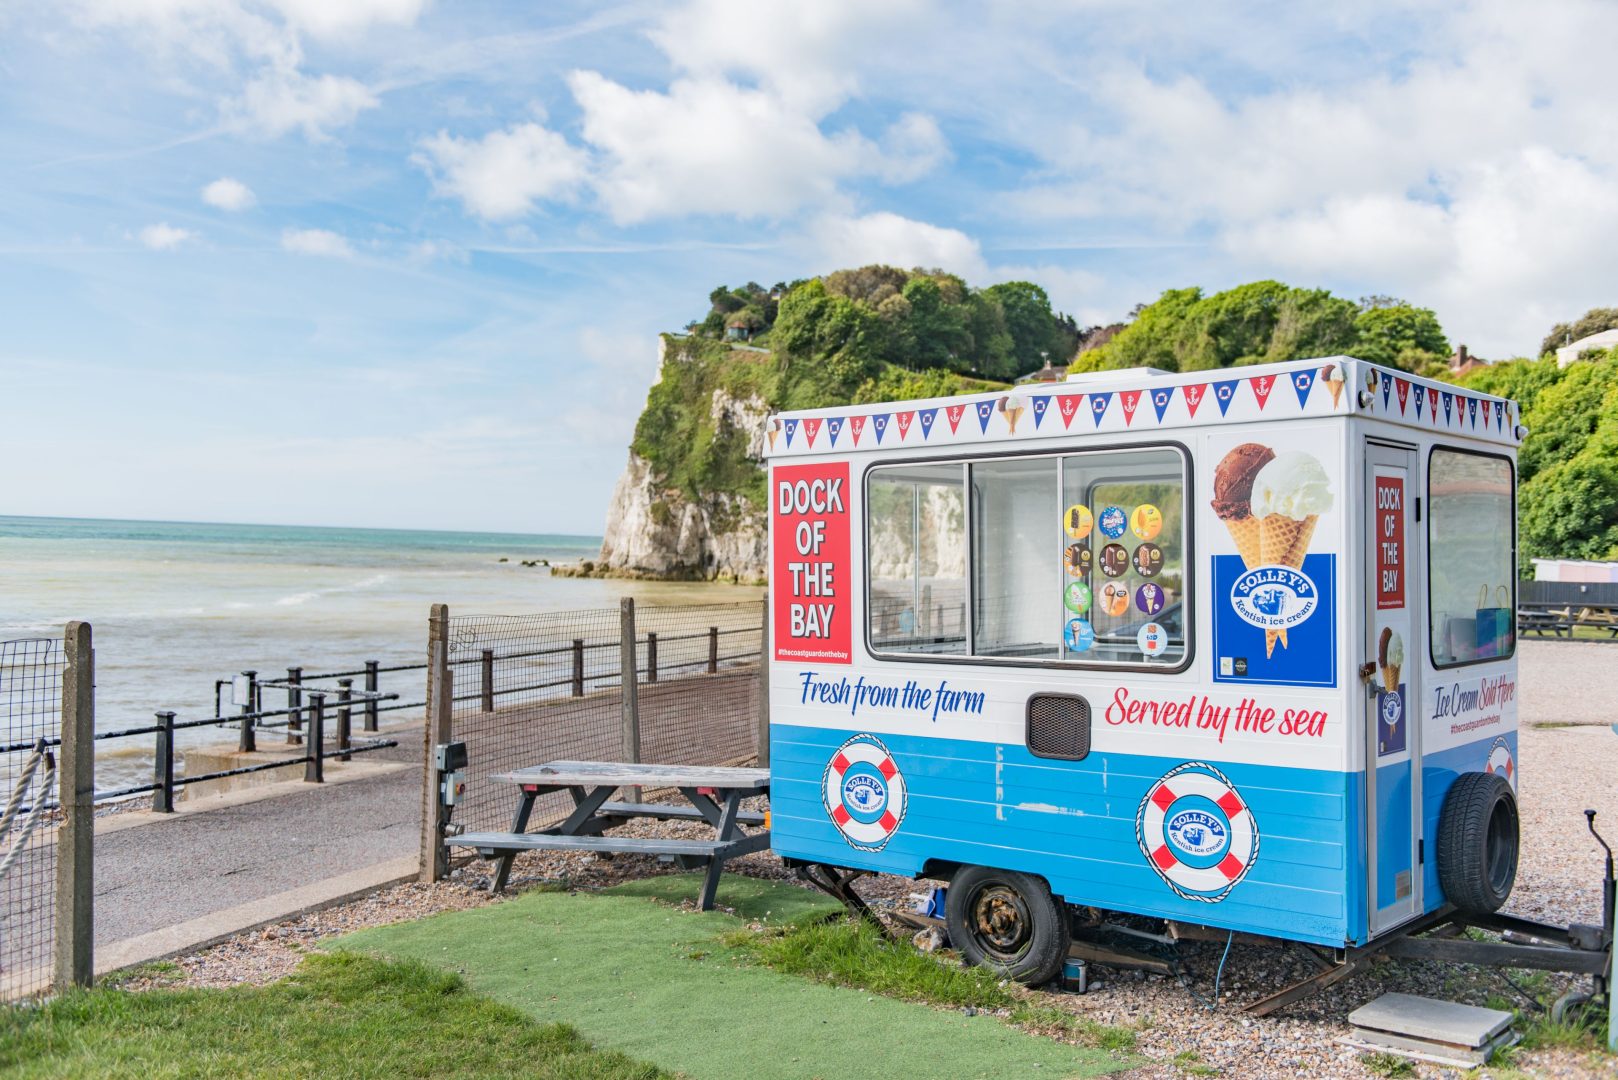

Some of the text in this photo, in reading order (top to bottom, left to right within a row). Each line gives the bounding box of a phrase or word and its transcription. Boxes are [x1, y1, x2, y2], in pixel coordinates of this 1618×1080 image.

[779, 478, 844, 515] DOCK
[1378, 487, 1401, 510] DOCK
[795, 520, 826, 556] OF
[1384, 514, 1395, 538] OF
[1382, 542, 1398, 565] THE
[788, 562, 835, 597] THE
[1239, 570, 1310, 594] SOLLEY'S
[1382, 570, 1398, 593] BAY
[790, 603, 835, 638] BAY
[1235, 599, 1313, 625] Kentish ice cream
[800, 671, 985, 722] Fresh from the farm
[1432, 686, 1450, 720] Ice
[1451, 683, 1478, 717] Cream
[1479, 678, 1497, 710] Sold
[1498, 674, 1514, 710] Here
[1105, 687, 1328, 744] Served by the sea
[1173, 813, 1221, 833] SOLLEY'S
[1171, 832, 1193, 852] Kentish
[1206, 838, 1224, 853] cream
